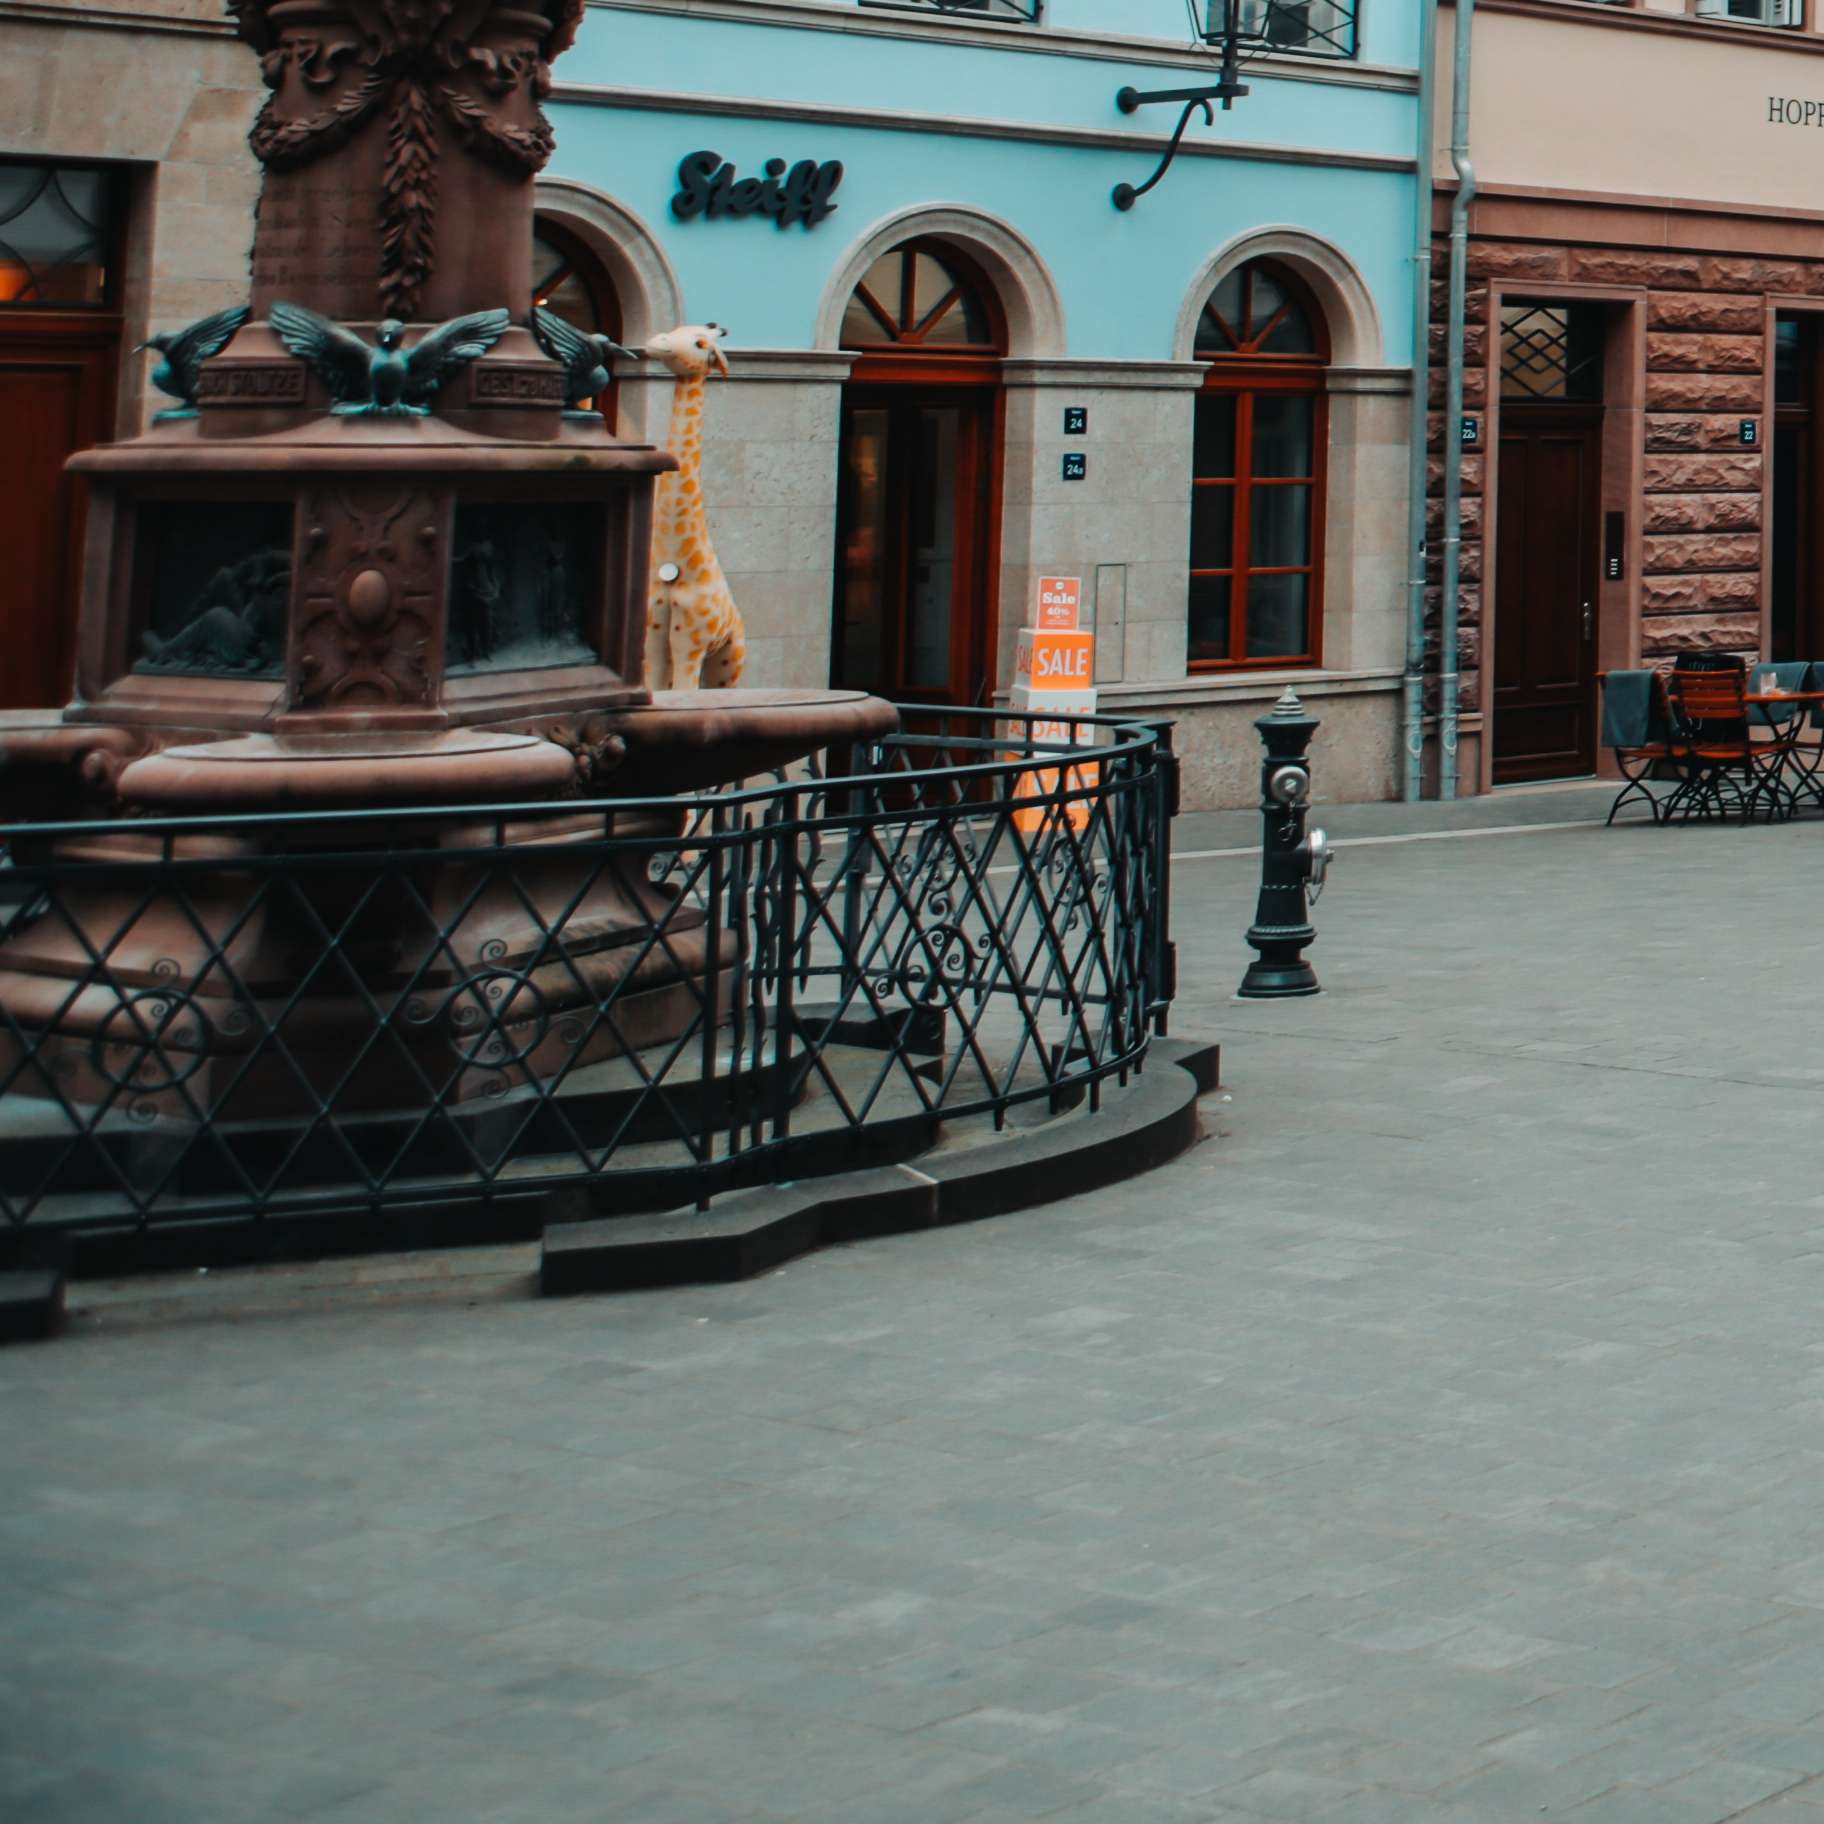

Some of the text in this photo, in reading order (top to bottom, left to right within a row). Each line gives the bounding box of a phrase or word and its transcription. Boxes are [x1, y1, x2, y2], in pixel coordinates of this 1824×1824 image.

[671, 150, 843, 231] Steiff
[1070, 418, 1082, 429] 24
[1744, 431, 1754, 440] 22
[1042, 592, 1076, 604] Sale
[1038, 647, 1088, 676] SALE
